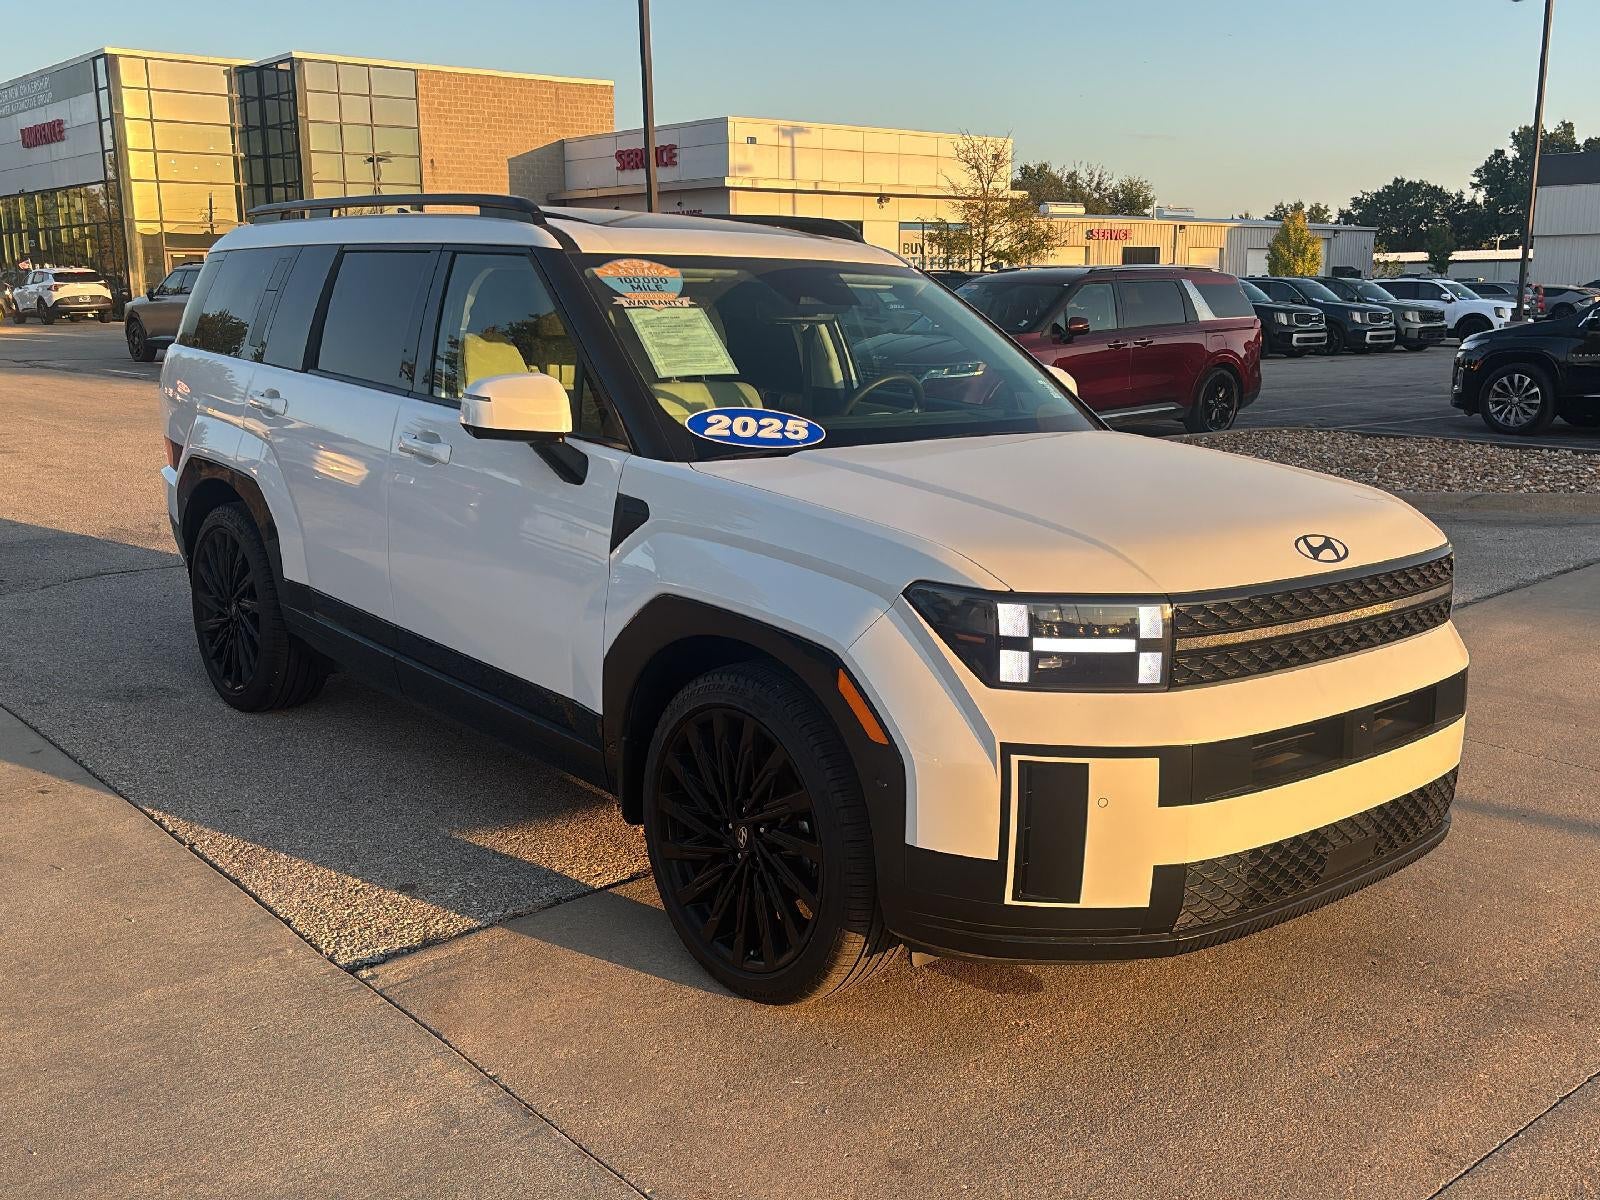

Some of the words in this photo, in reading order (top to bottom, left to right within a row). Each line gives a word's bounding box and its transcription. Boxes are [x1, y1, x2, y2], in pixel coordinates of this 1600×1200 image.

[20, 119, 65, 148] LAWRENCE
[615, 144, 678, 171] SERICE
[1092, 229, 1132, 241] SERVICE
[903, 243, 925, 255] BUY
[629, 268, 659, 276] YEAR
[704, 414, 809, 440] 2025
